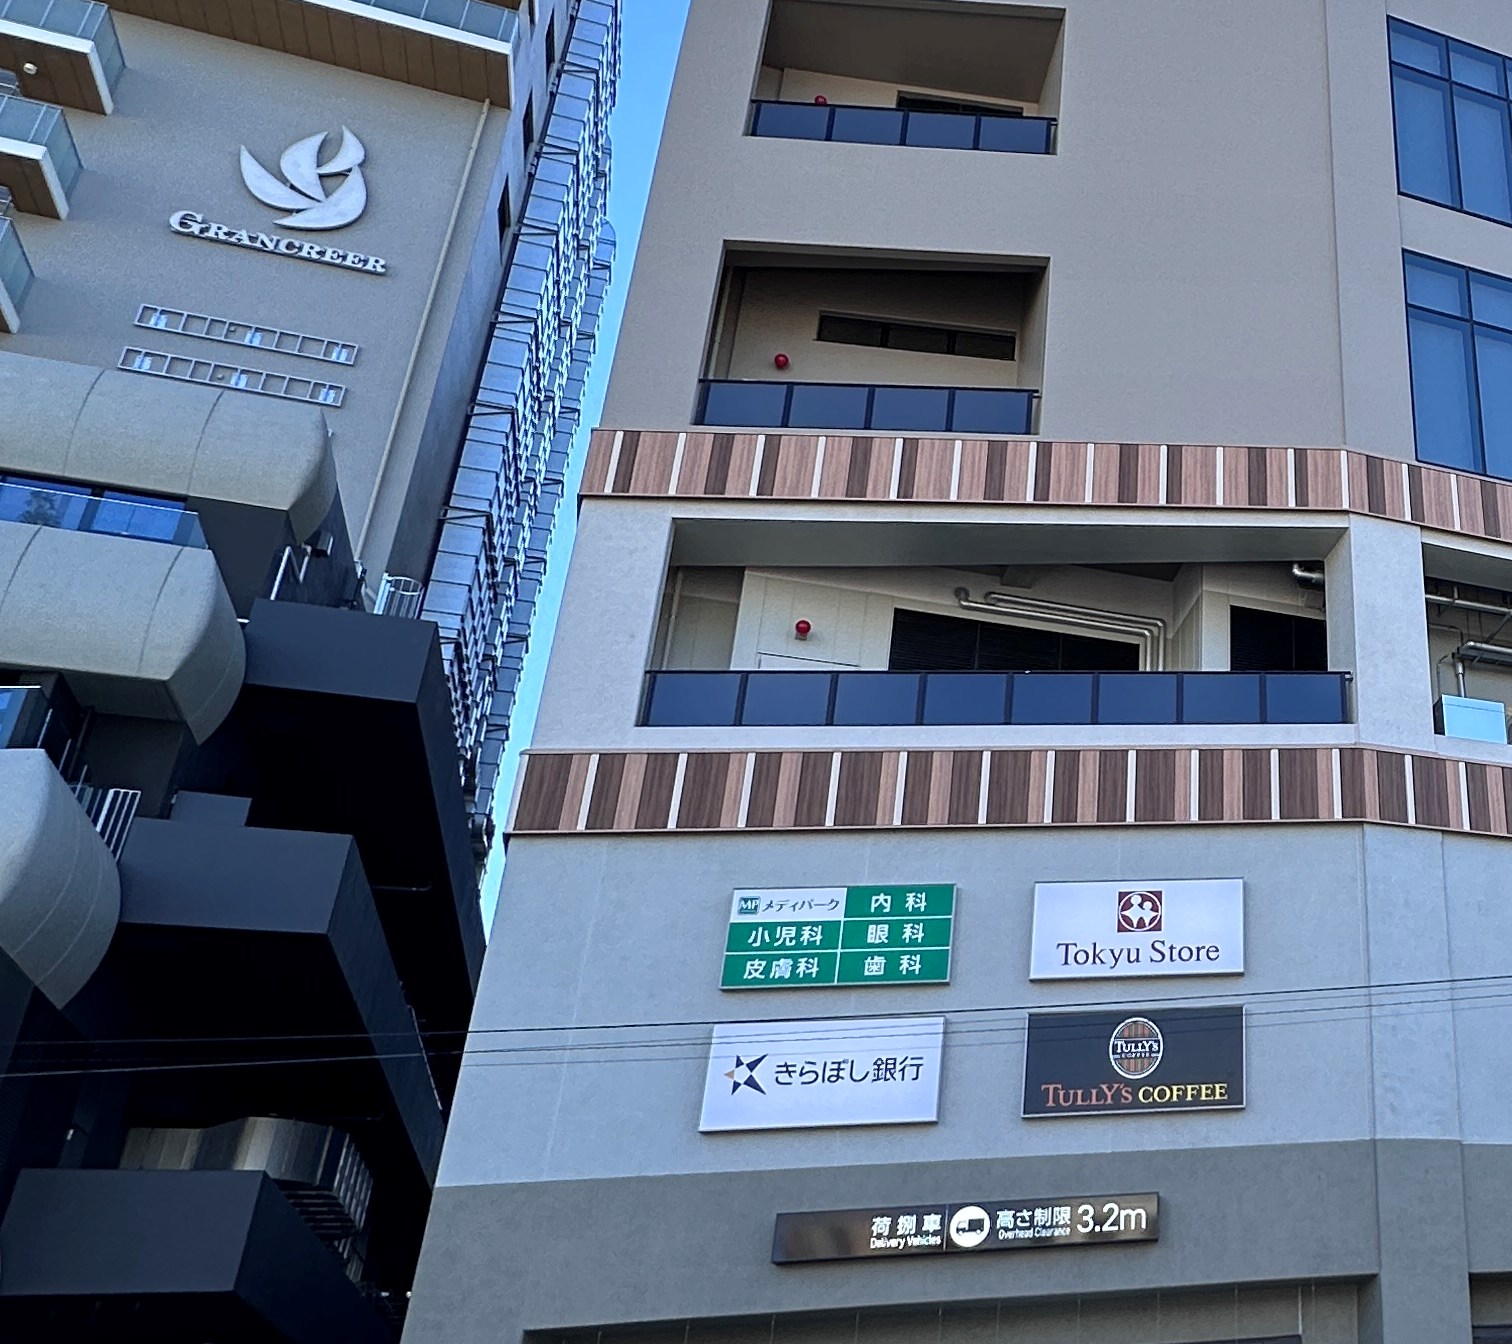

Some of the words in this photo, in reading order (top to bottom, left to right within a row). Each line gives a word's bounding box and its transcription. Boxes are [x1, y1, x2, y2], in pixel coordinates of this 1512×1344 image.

[169, 210, 386, 275] GRANCREER
[870, 892, 927, 912] 内科
[748, 925, 823, 947] 小児科
[867, 922, 924, 944] 眼科
[864, 954, 921, 975] 歯科
[1057, 942, 1141, 969] Tokyu
[1150, 939, 1220, 963] Store
[743, 958, 819, 979] 皮膚科
[774, 1056, 924, 1085] きらぼし銀行
[1138, 1083, 1229, 1104] COFFEE
[996, 1206, 1072, 1229] 高さ制限
[1076, 1202, 1147, 1233] 3.2m
[870, 1237, 906, 1250] Delivery
[906, 1235, 942, 1247] Vehicles
